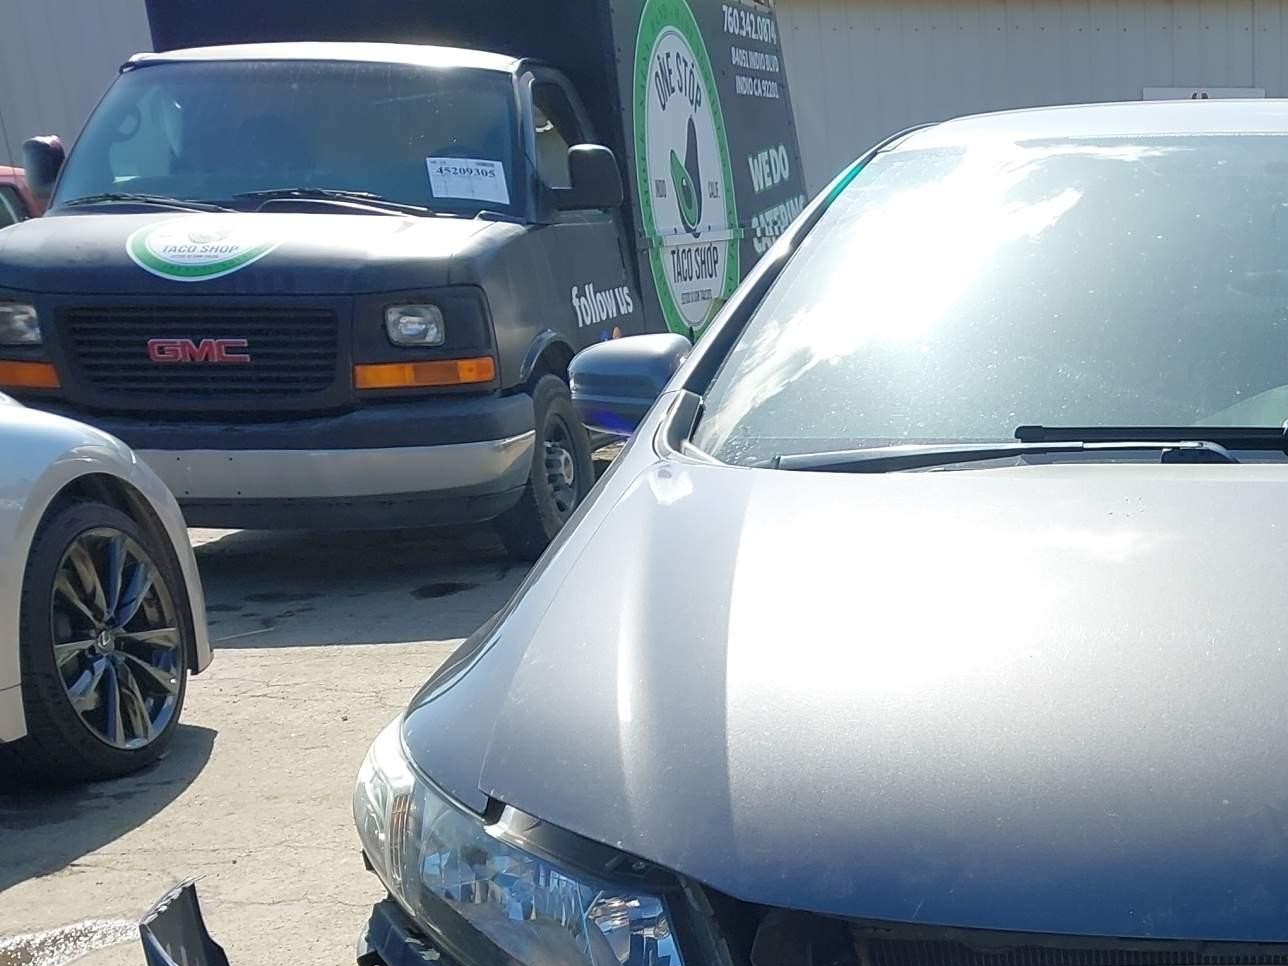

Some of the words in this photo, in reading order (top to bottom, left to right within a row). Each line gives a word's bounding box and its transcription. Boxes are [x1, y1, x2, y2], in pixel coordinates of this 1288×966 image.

[722, 5, 777, 45] 760.342.0874
[654, 52, 676, 111] ONE
[675, 51, 702, 113] STOP
[753, 78, 762, 97] CA
[435, 166, 496, 178] 45209305
[747, 150, 774, 193] WE
[769, 144, 790, 184] DO
[162, 244, 198, 254] TACO
[199, 244, 240, 254] SHOP
[670, 248, 694, 284] TACO
[694, 245, 720, 280] SHOP
[571, 282, 617, 328] follow
[614, 286, 634, 315] us
[147, 338, 251, 362] GMC
